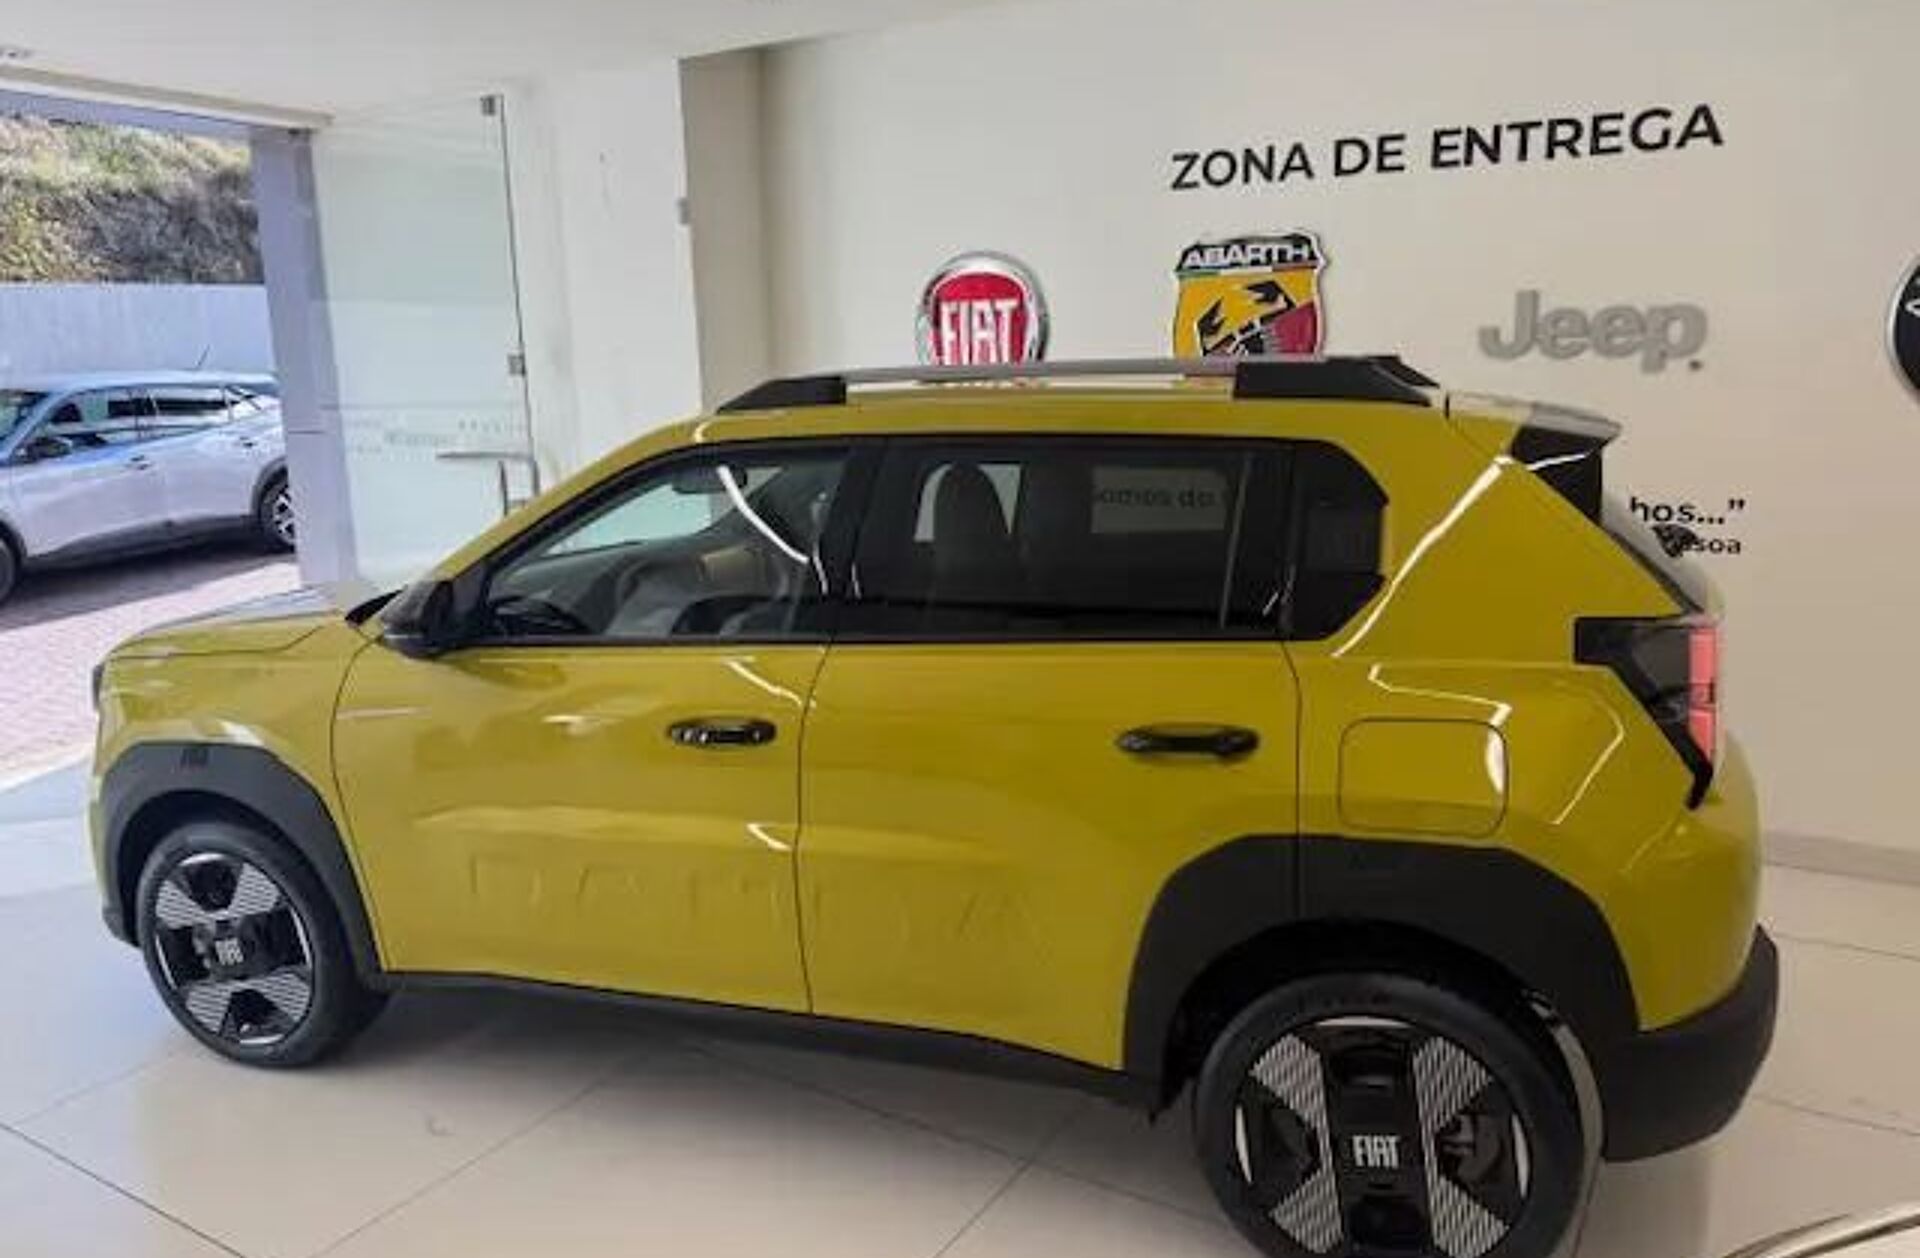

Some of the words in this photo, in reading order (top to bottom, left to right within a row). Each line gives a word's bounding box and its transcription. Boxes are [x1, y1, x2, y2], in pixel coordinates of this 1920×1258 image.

[1170, 142, 1315, 191] ZONA
[1333, 133, 1407, 177] DE
[1429, 103, 1724, 169] ENTREGA
[1180, 243, 1312, 267] ABARTH
[940, 298, 1019, 365] FIAT
[1478, 289, 1708, 373] Jeep
[1352, 1134, 1400, 1169] FIAT
